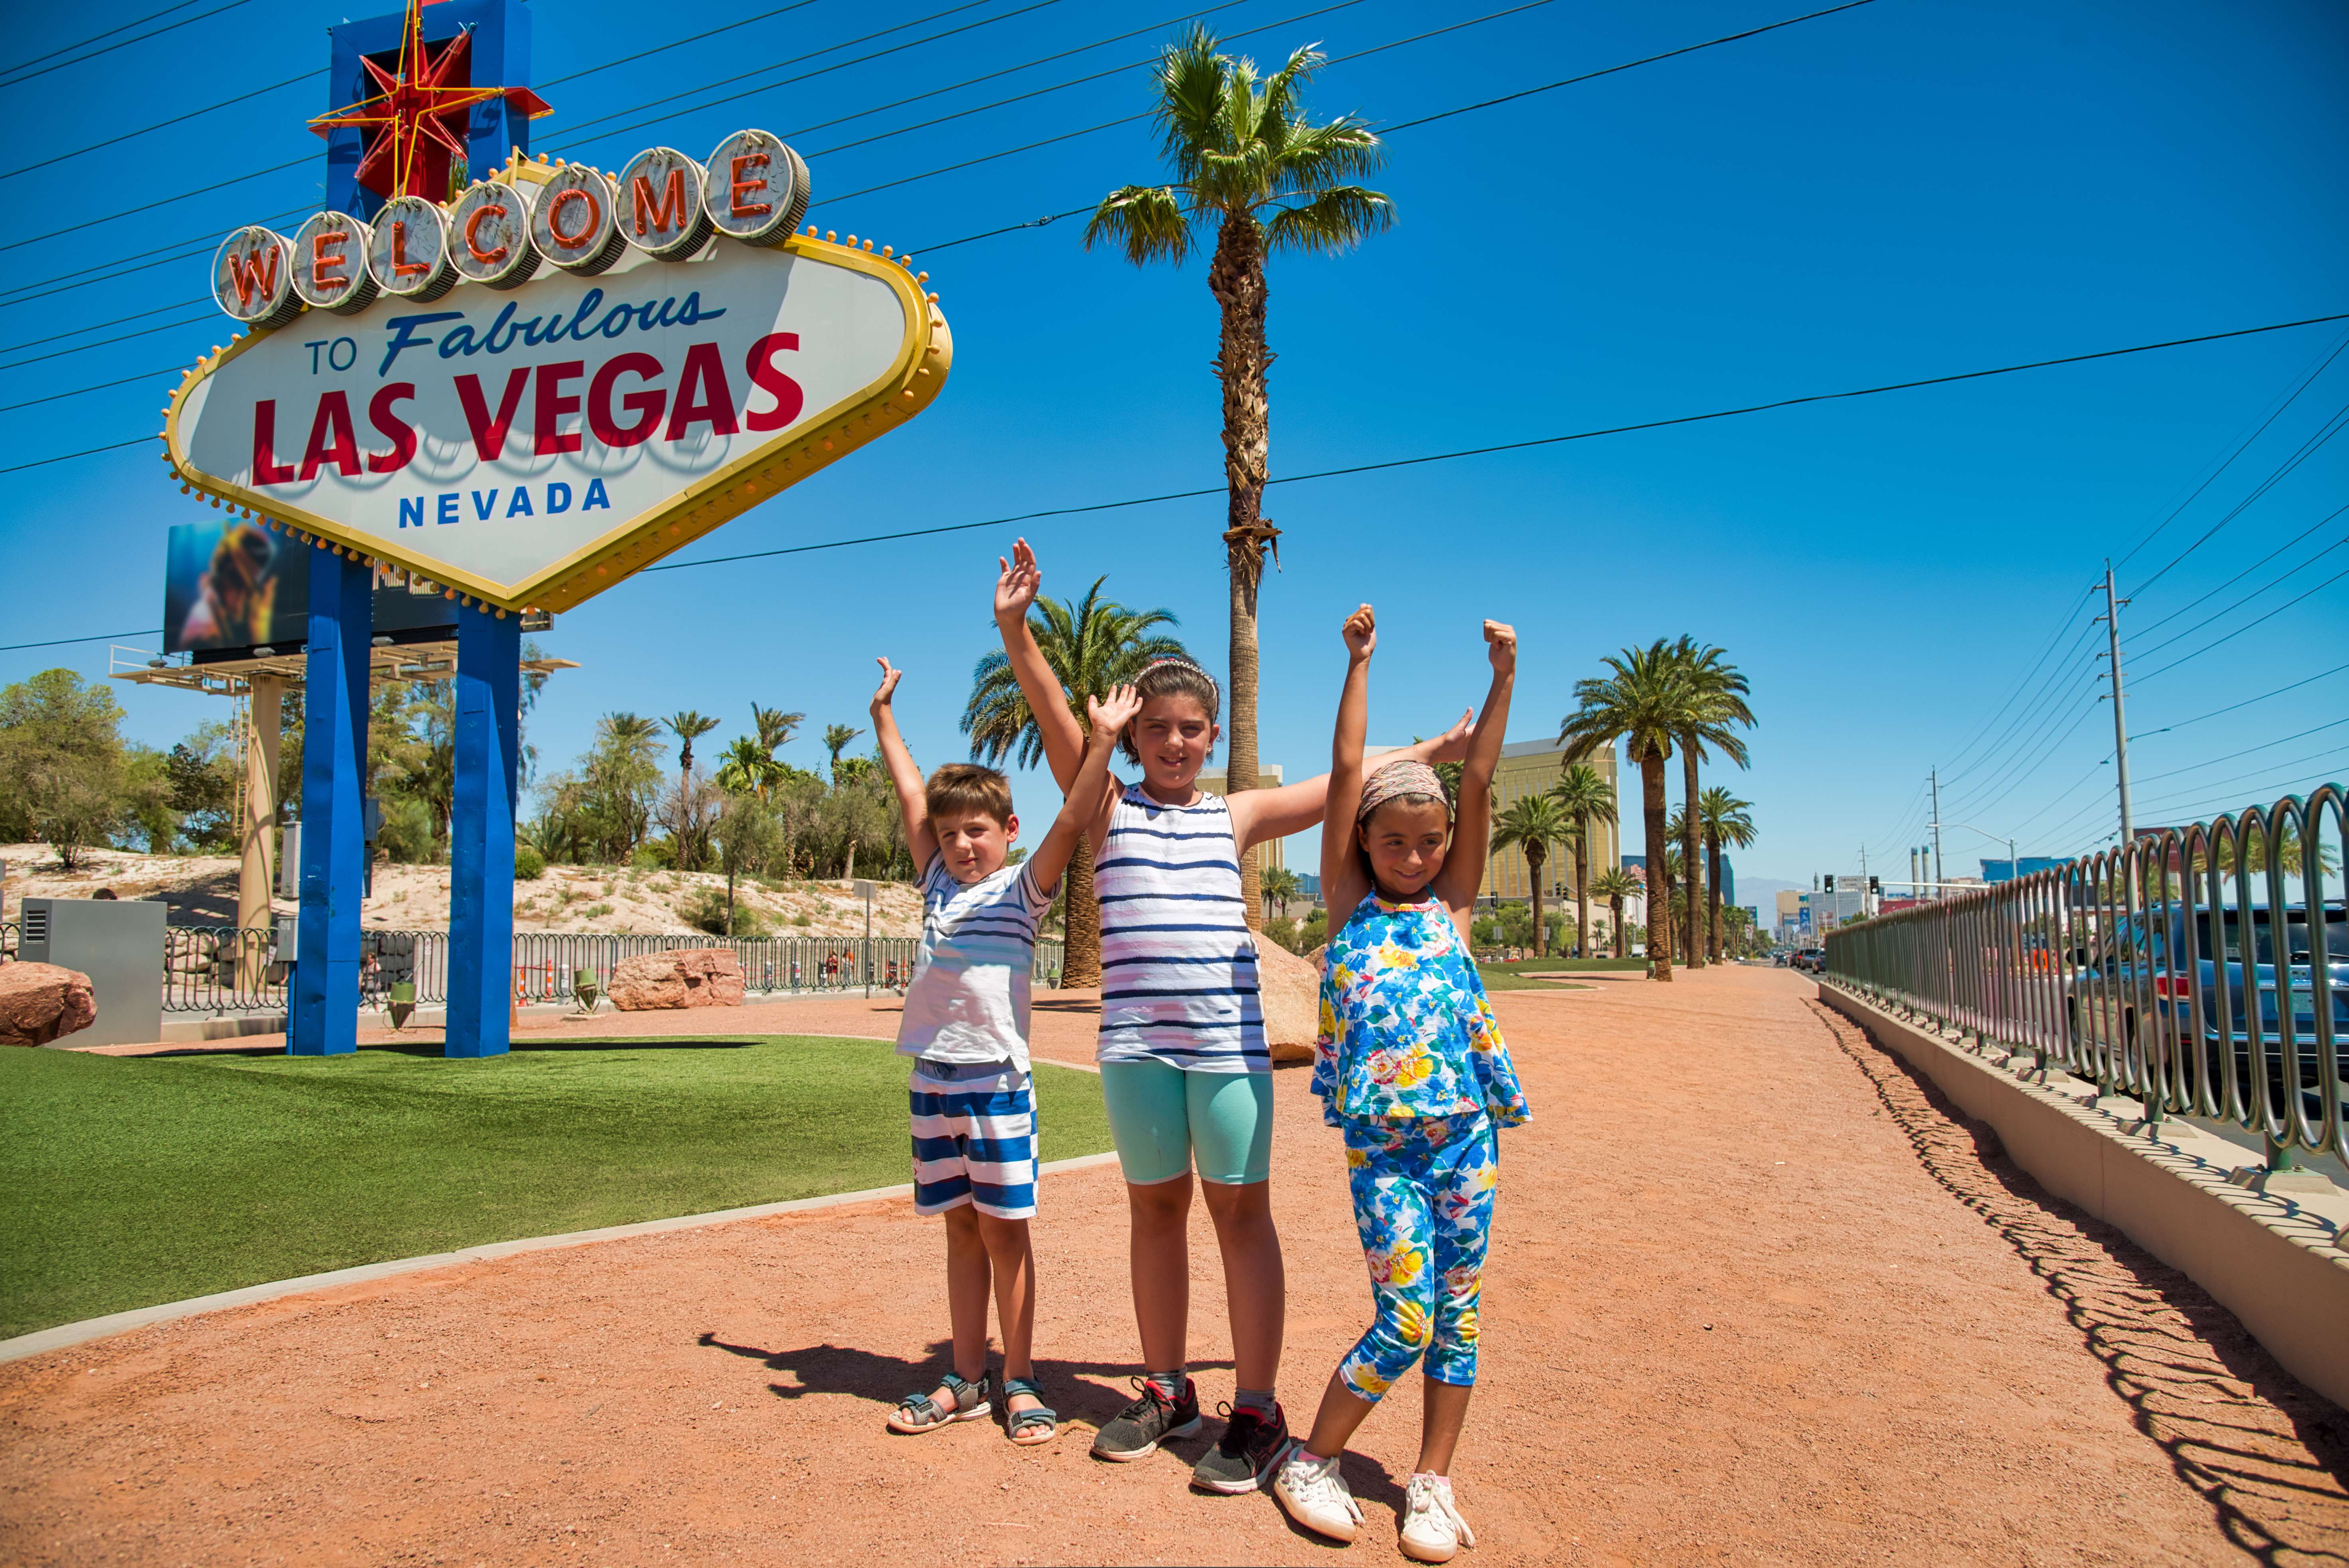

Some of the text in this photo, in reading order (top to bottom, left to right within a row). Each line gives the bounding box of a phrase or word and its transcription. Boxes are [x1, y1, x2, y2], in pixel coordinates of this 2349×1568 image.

[228, 153, 771, 307] WELCOME
[303, 288, 728, 379] TO Fabulous
[252, 332, 804, 487] LAS VEGAS
[398, 476, 611, 529] NEVADA
